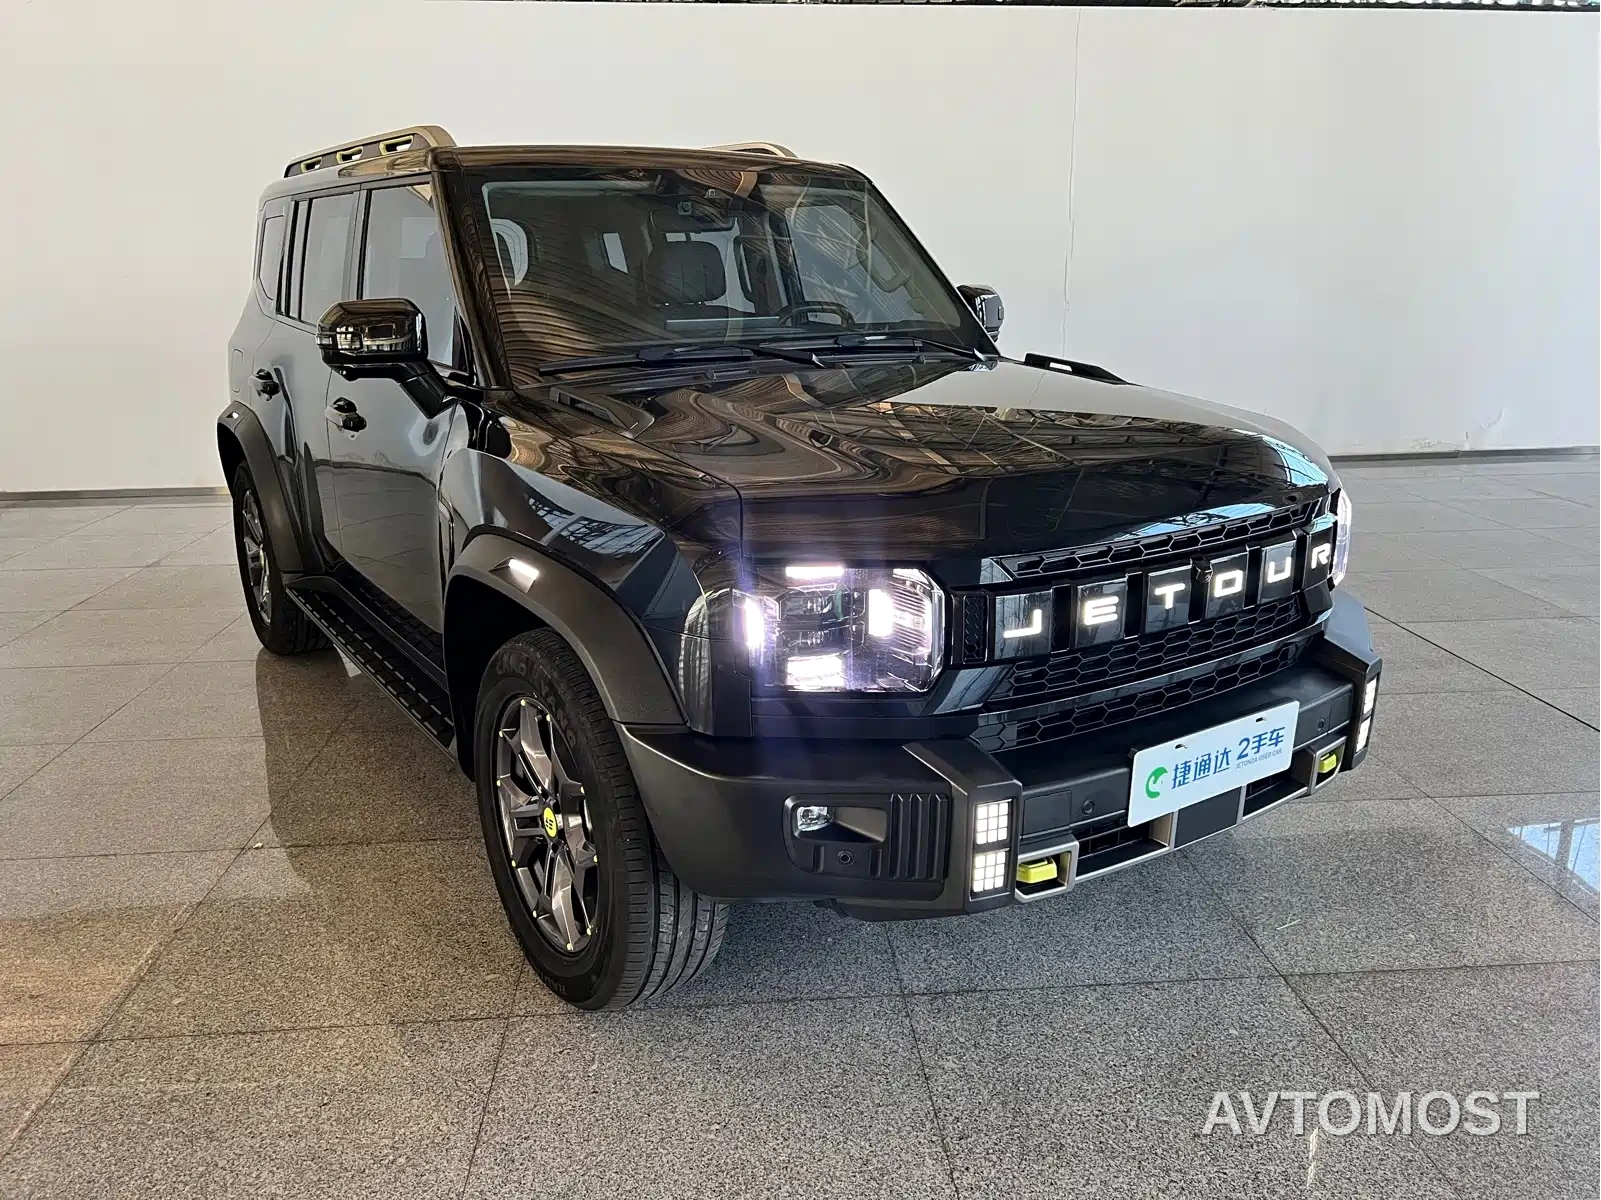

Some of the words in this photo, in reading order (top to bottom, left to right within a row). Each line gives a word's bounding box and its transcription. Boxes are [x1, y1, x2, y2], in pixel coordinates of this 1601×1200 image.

[1003, 542, 1331, 638] JETOUR
[1171, 748, 1232, 789] 捷通达
[1236, 727, 1286, 760] 2手车
[1272, 747, 1283, 757] CAR
